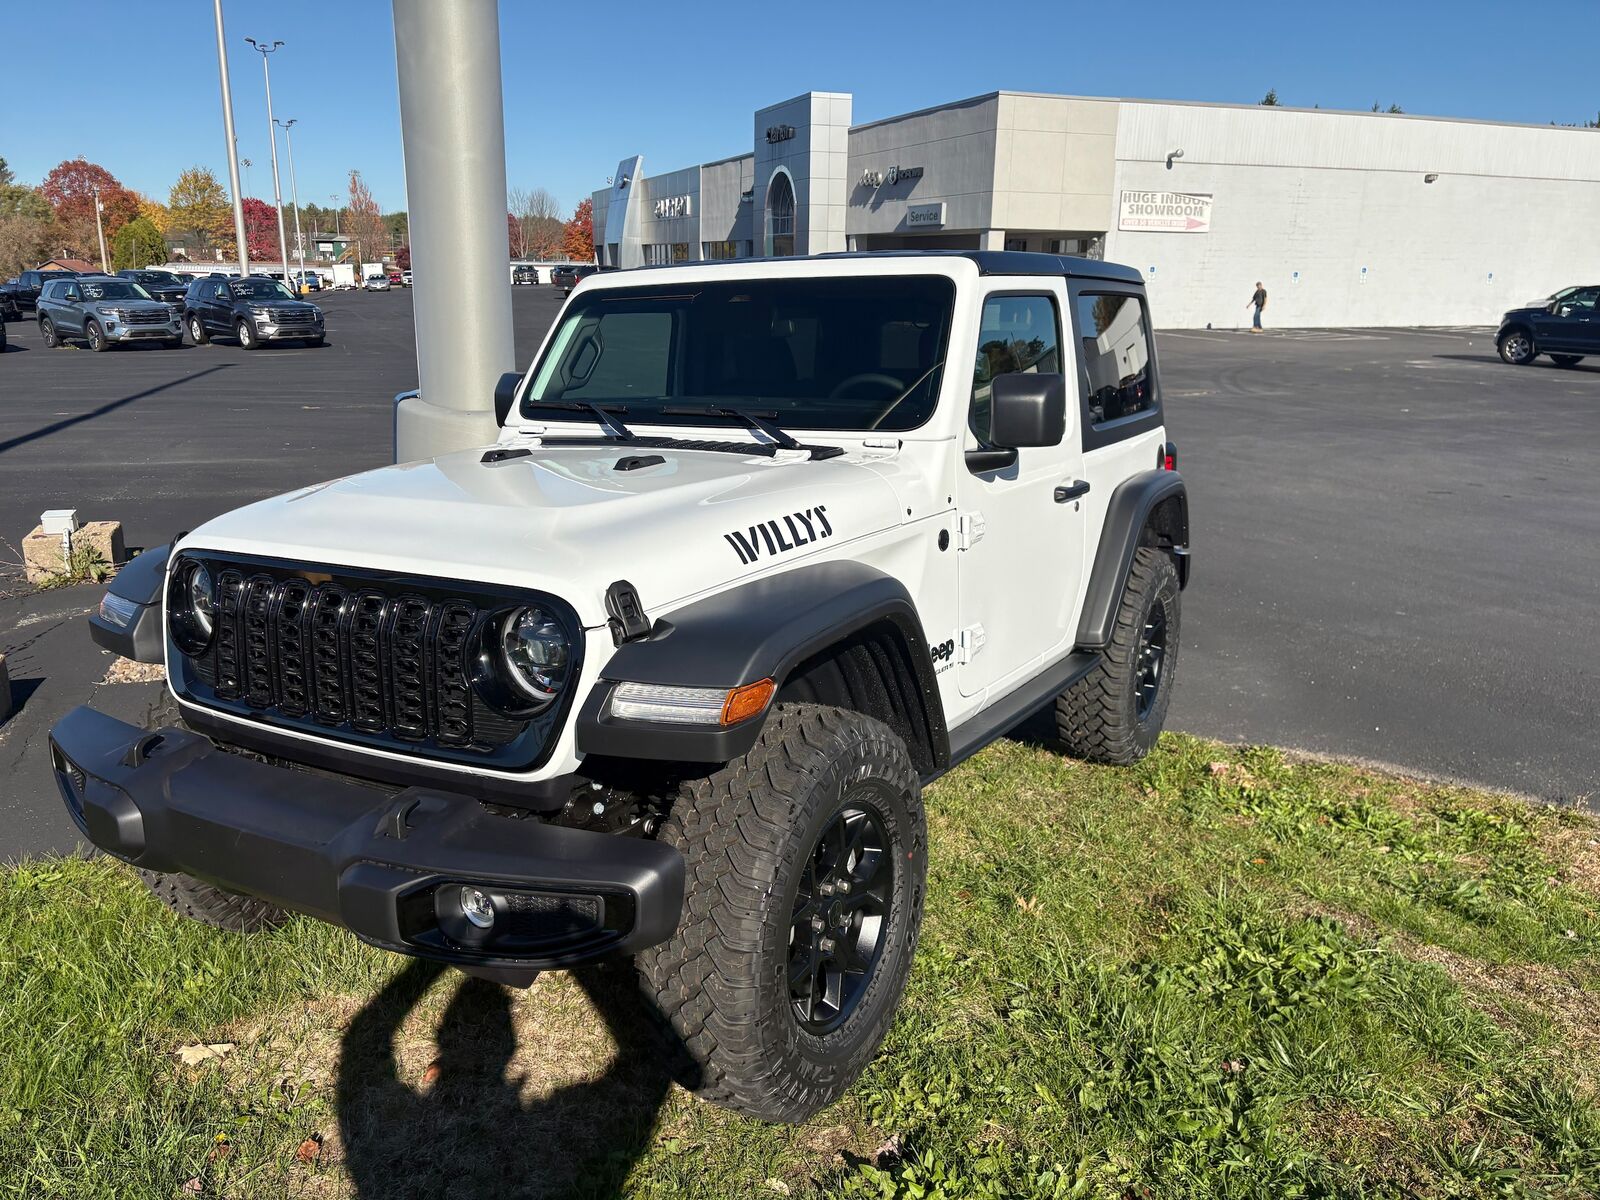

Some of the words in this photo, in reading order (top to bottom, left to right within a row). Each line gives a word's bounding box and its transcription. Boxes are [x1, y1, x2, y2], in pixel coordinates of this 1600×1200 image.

[1123, 192, 1157, 204] HUGE
[910, 211, 938, 222] Service
[1128, 203, 1203, 217] SHOWROOM
[724, 505, 833, 565] WILLYS
[928, 639, 954, 663] eep
